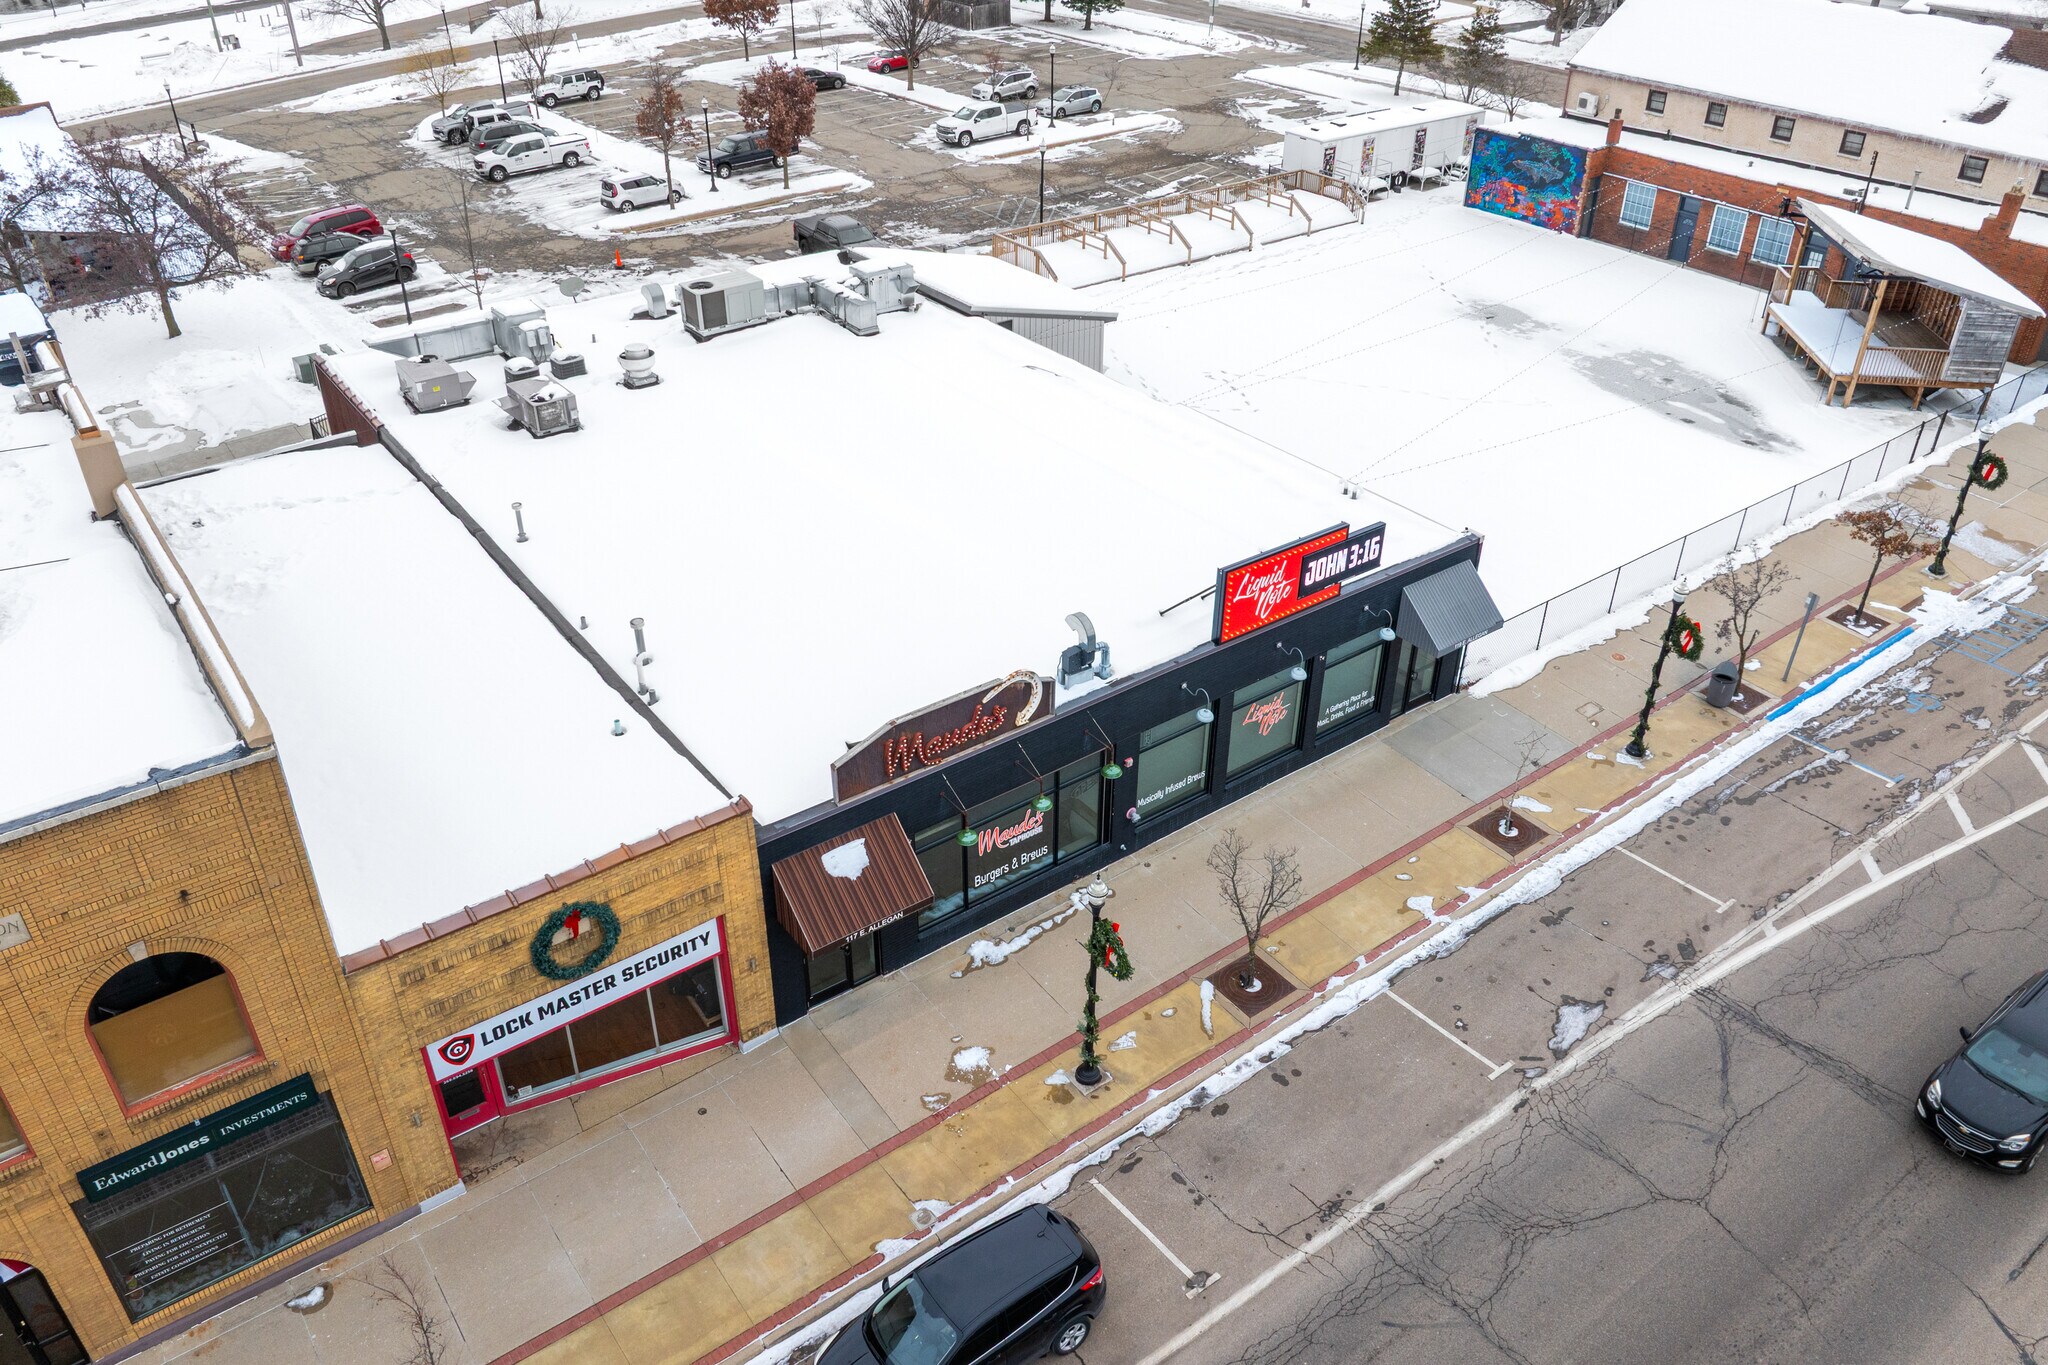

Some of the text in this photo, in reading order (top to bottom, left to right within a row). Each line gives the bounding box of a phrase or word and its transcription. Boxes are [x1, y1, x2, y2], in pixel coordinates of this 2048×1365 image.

[1304, 535, 1381, 586] JOHN 3:16
[1233, 560, 1287, 603] Liquid
[1255, 577, 1296, 619] Note
[1242, 691, 1285, 726] Liquid
[1258, 702, 1291, 736] Note
[1330, 699, 1350, 712] Gathering
[1350, 693, 1361, 703] Place
[1361, 690, 1369, 698] for
[1345, 703, 1356, 714] Food
[1360, 695, 1375, 707] Friends
[884, 704, 1007, 778] Maude's
[1137, 770, 1206, 807] Musically Infused Brews
[978, 809, 1044, 856] Maude's
[1009, 825, 1044, 846] TAPHOUSE
[974, 845, 1048, 887] Burgers & Brews
[845, 911, 904, 943] 117 E. ALLEGAN
[480, 931, 711, 1046] LOCK MASTER SECURITY
[220, 1091, 308, 1136] INVESTMENTS
[130, 1213, 211, 1253] PREPARING FOR RETIREMENT
[142, 1245, 162, 1257] LIVING
[170, 1224, 206, 1244] RETIREMENT
[145, 1232, 211, 1264] PAYING FOR EDUCATION
[134, 1261, 166, 1278] PREPARING
[179, 1249, 191, 1257] THE
[191, 1232, 228, 1252] UNEXPECTED
[150, 1245, 219, 1280] ESTATE CONSIDERATIONS
